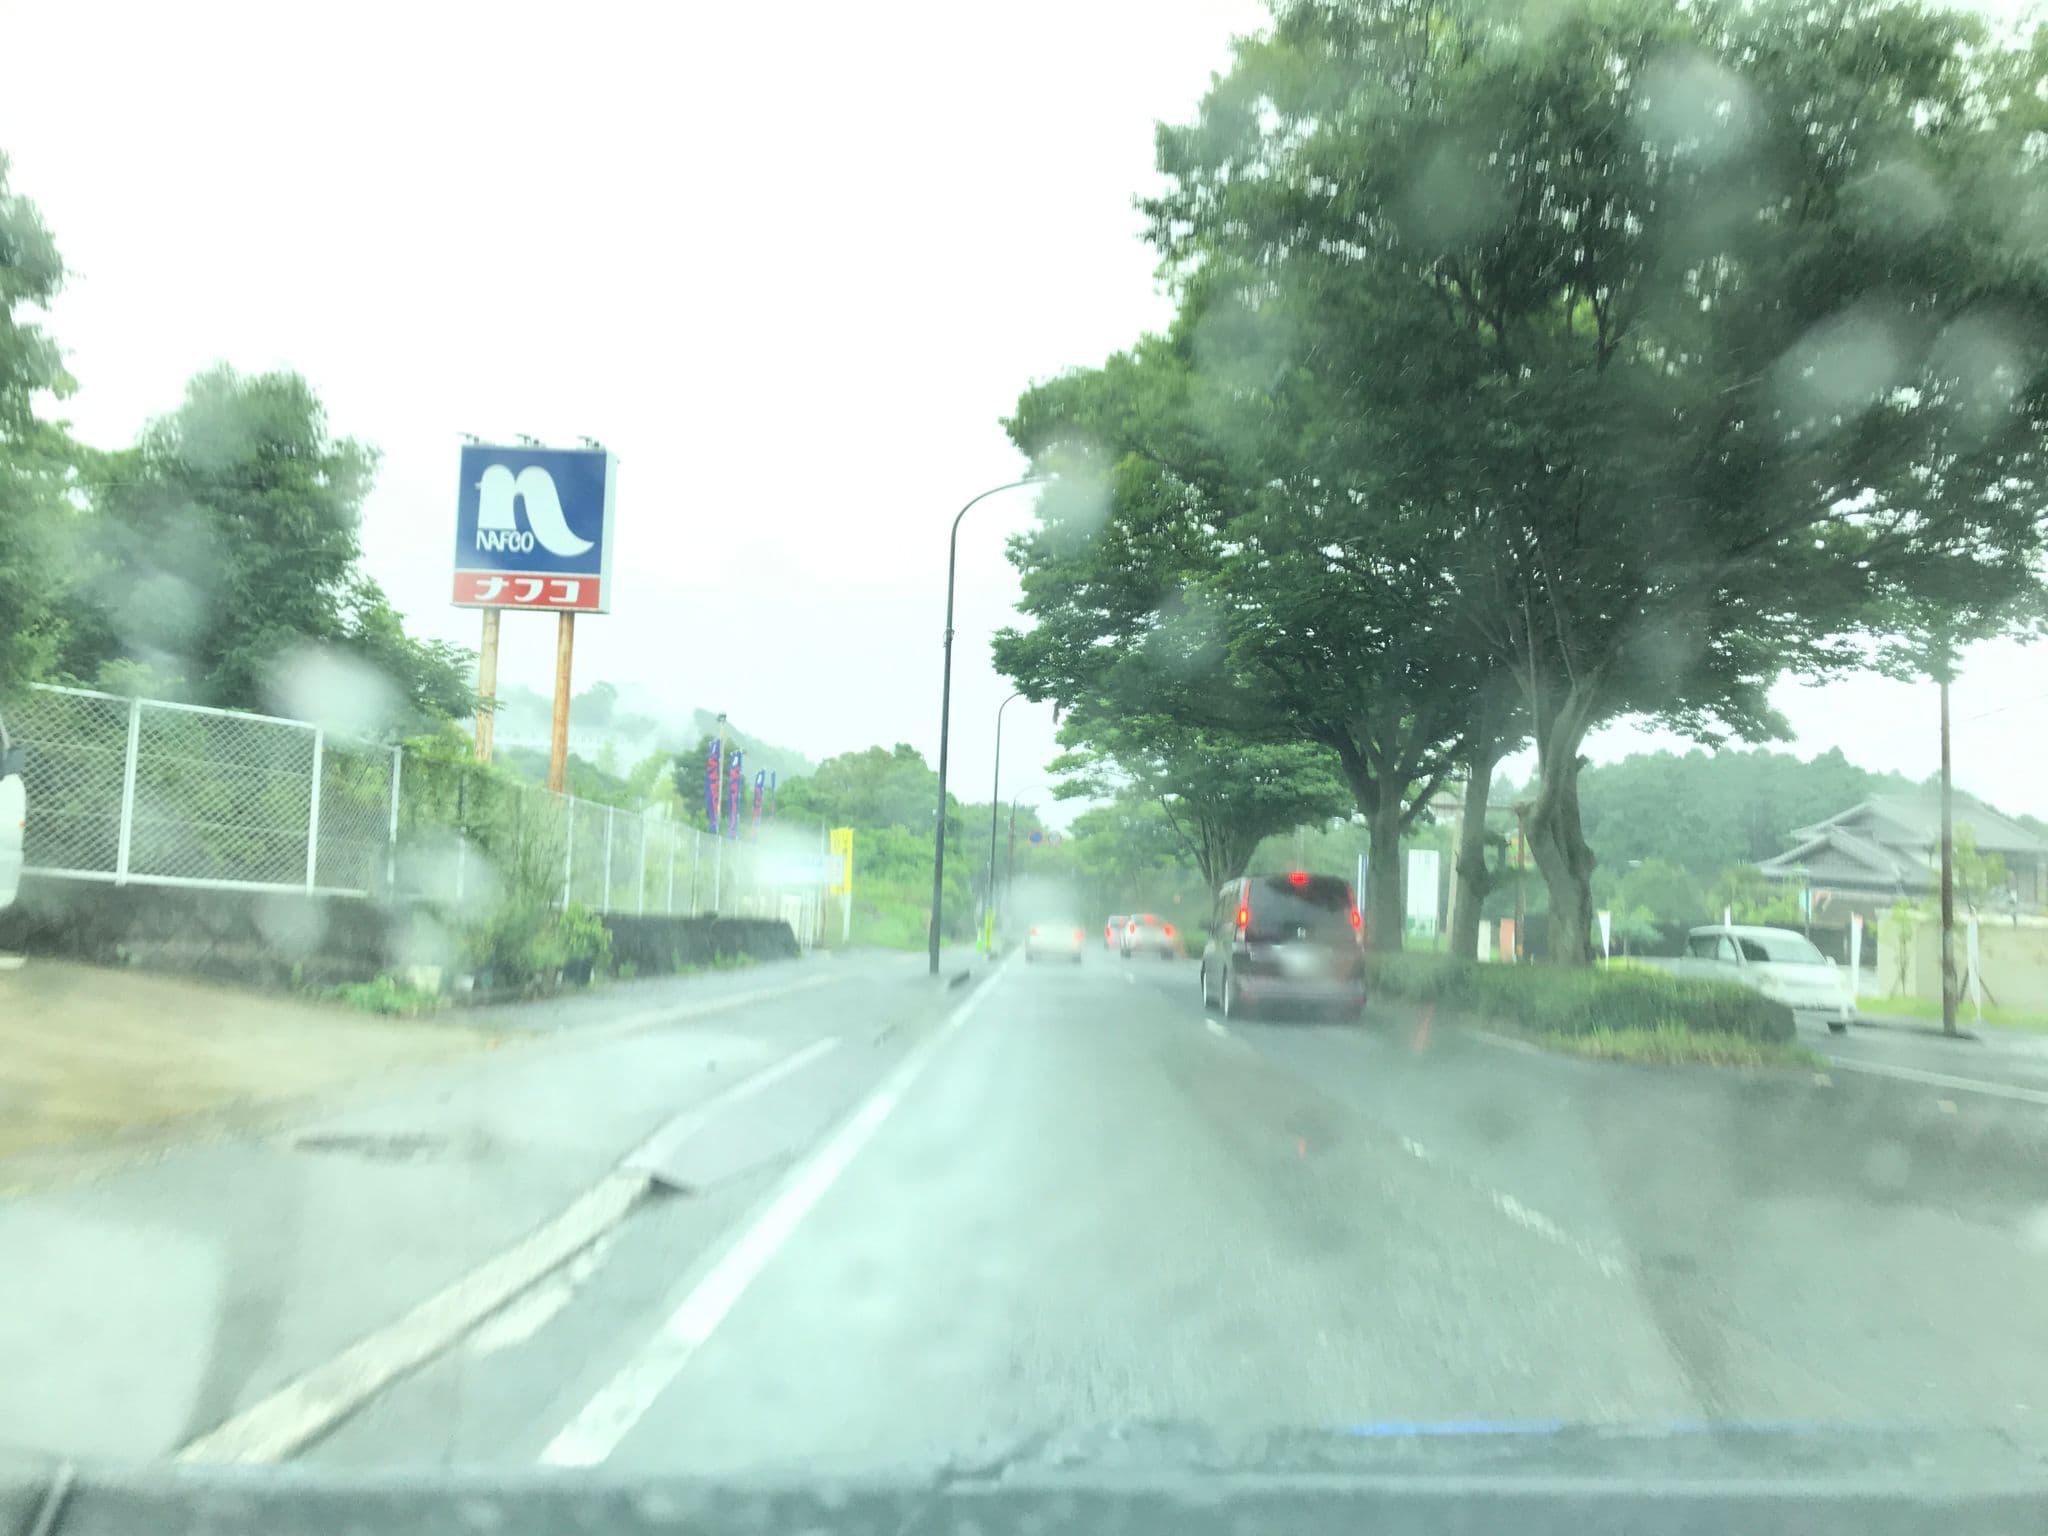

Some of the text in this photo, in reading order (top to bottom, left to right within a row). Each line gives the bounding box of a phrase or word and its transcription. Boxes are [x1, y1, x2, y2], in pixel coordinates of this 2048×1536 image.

[476, 530, 534, 553] NAFCO
[474, 576, 580, 603] ナフコ
